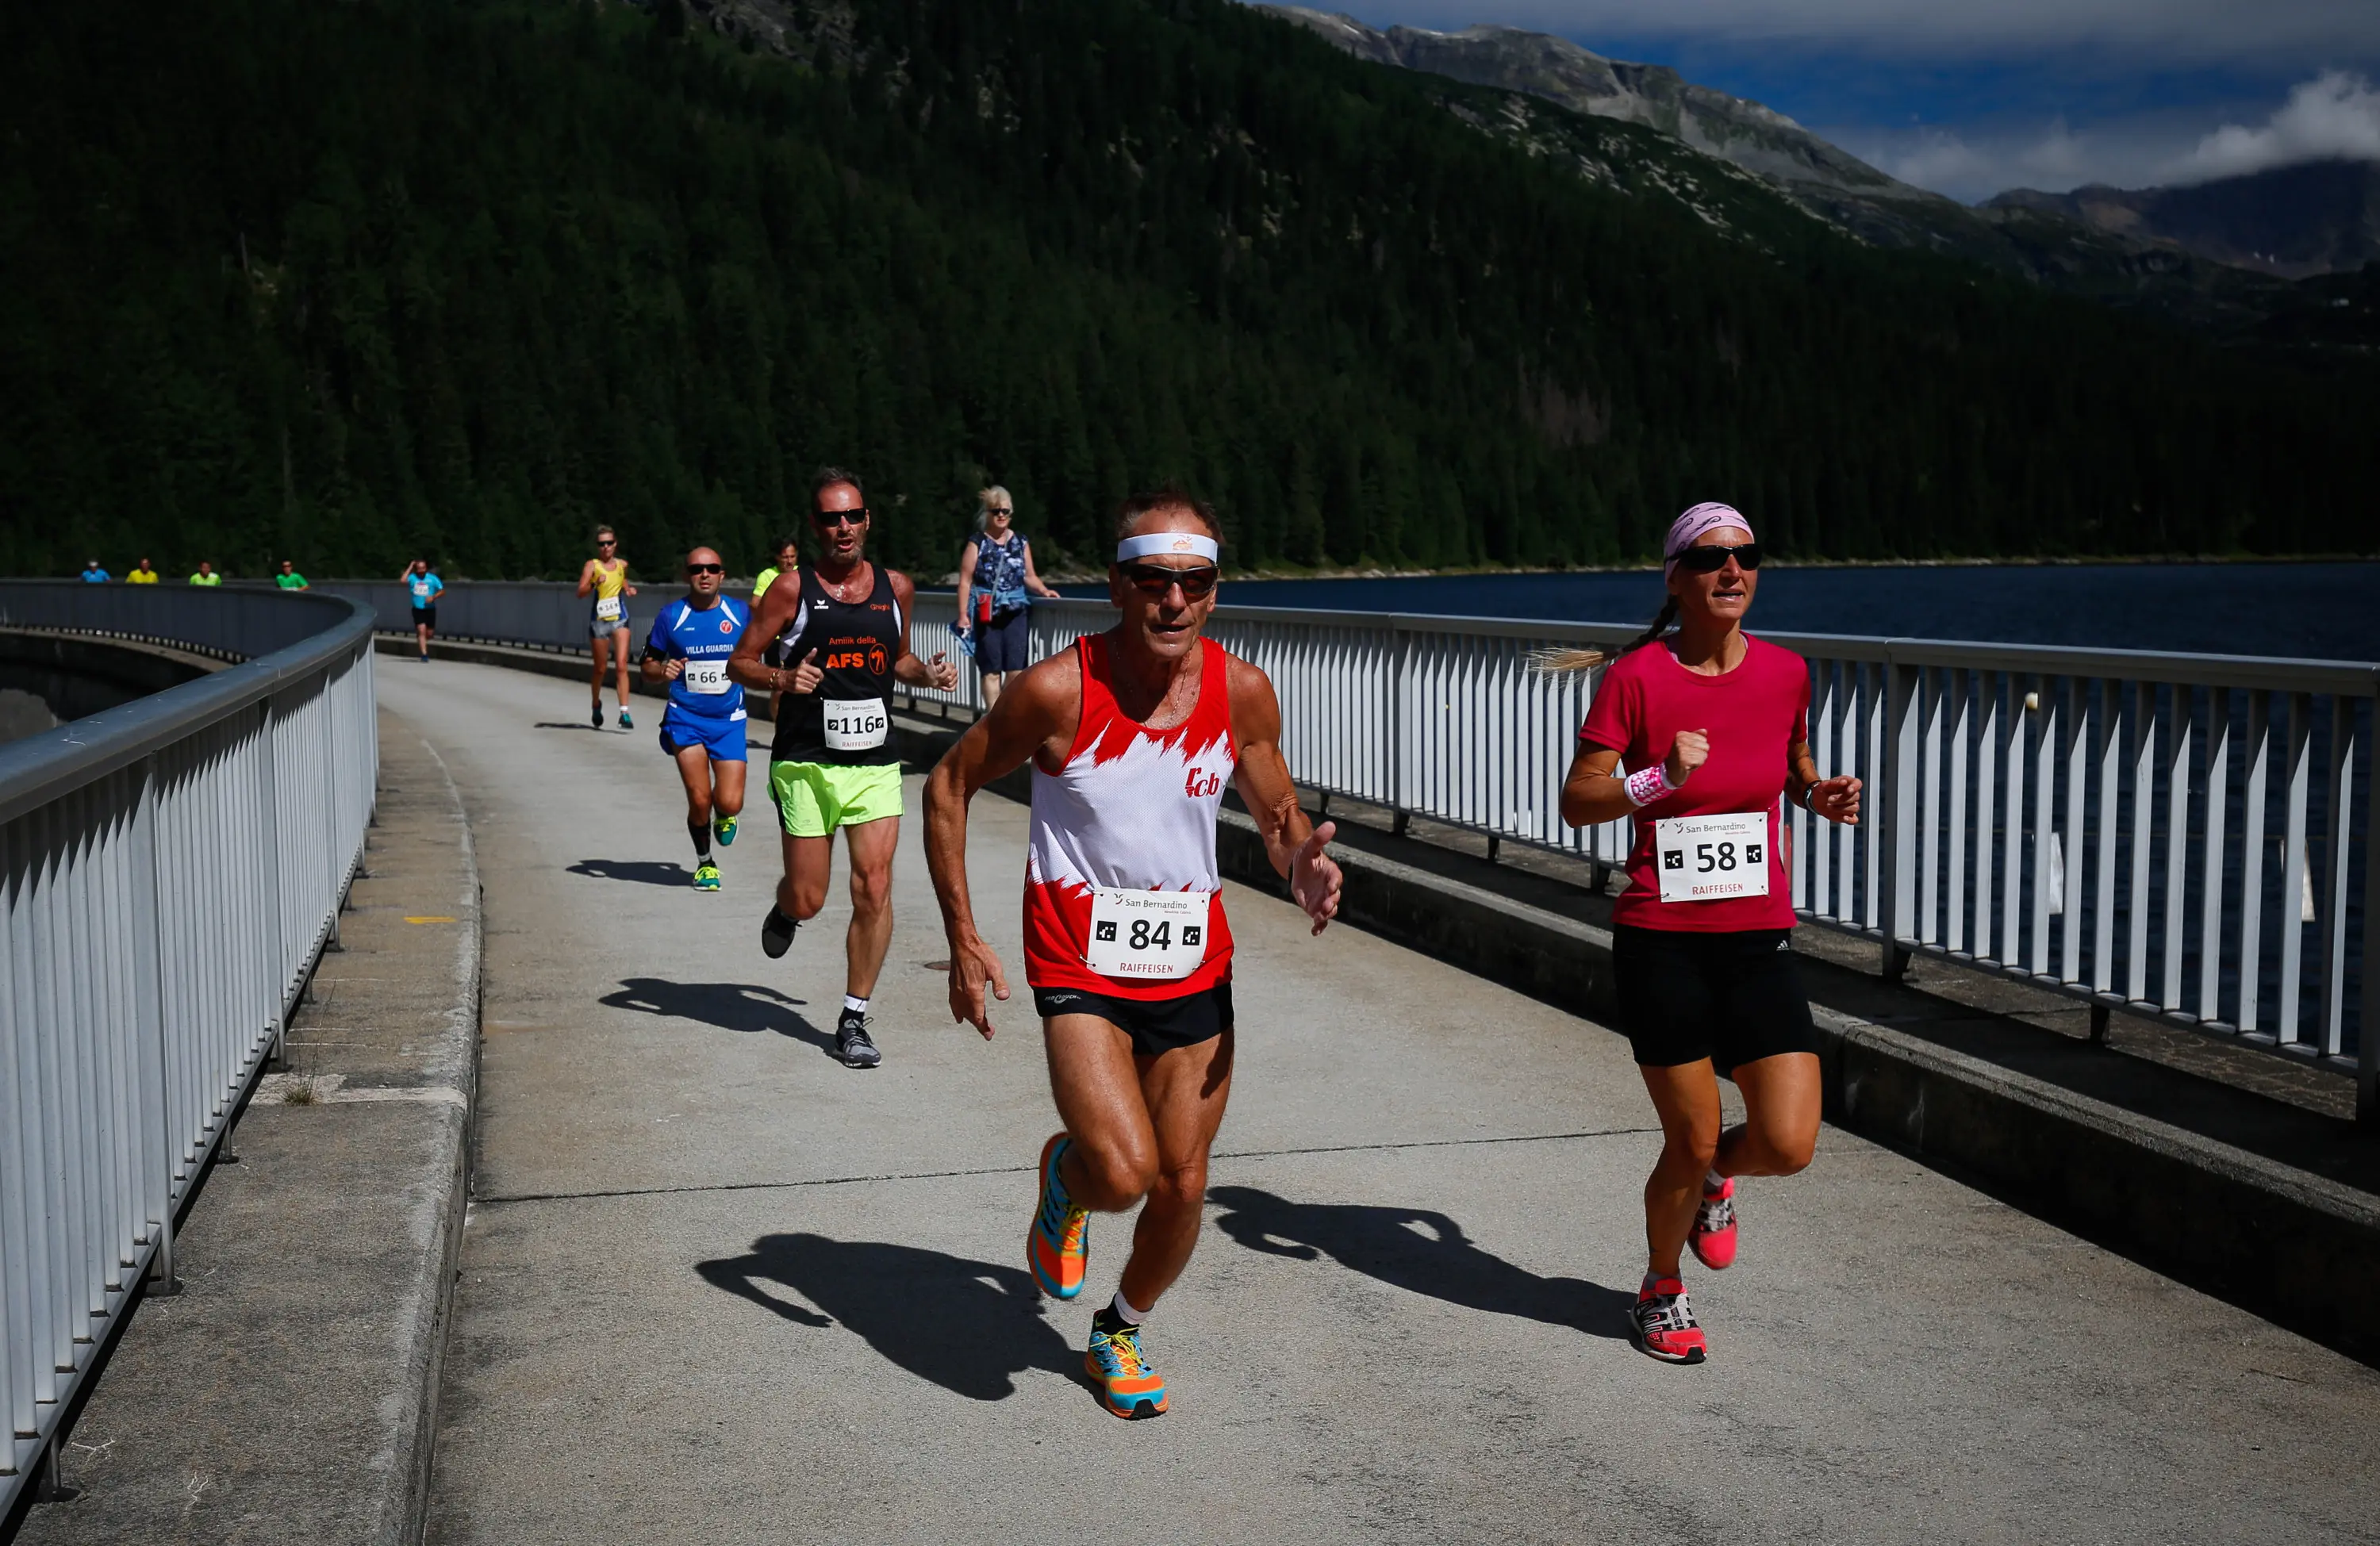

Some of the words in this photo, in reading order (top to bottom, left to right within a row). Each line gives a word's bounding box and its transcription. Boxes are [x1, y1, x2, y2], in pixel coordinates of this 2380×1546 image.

[685, 645, 704, 654] VILLA
[705, 644, 734, 654] GUARDIA
[826, 652, 865, 669] AFS
[700, 671, 717, 684] 66
[840, 715, 875, 735] 116
[1703, 823, 1746, 833] Bernardino
[1696, 842, 1737, 873] 58
[1691, 883, 1744, 896] RAIFFEISEN
[1125, 899, 1141, 907] San
[1143, 900, 1188, 910] Bernardino
[1129, 919, 1171, 950] 84
[1119, 962, 1174, 973] RAIFFEISEN
